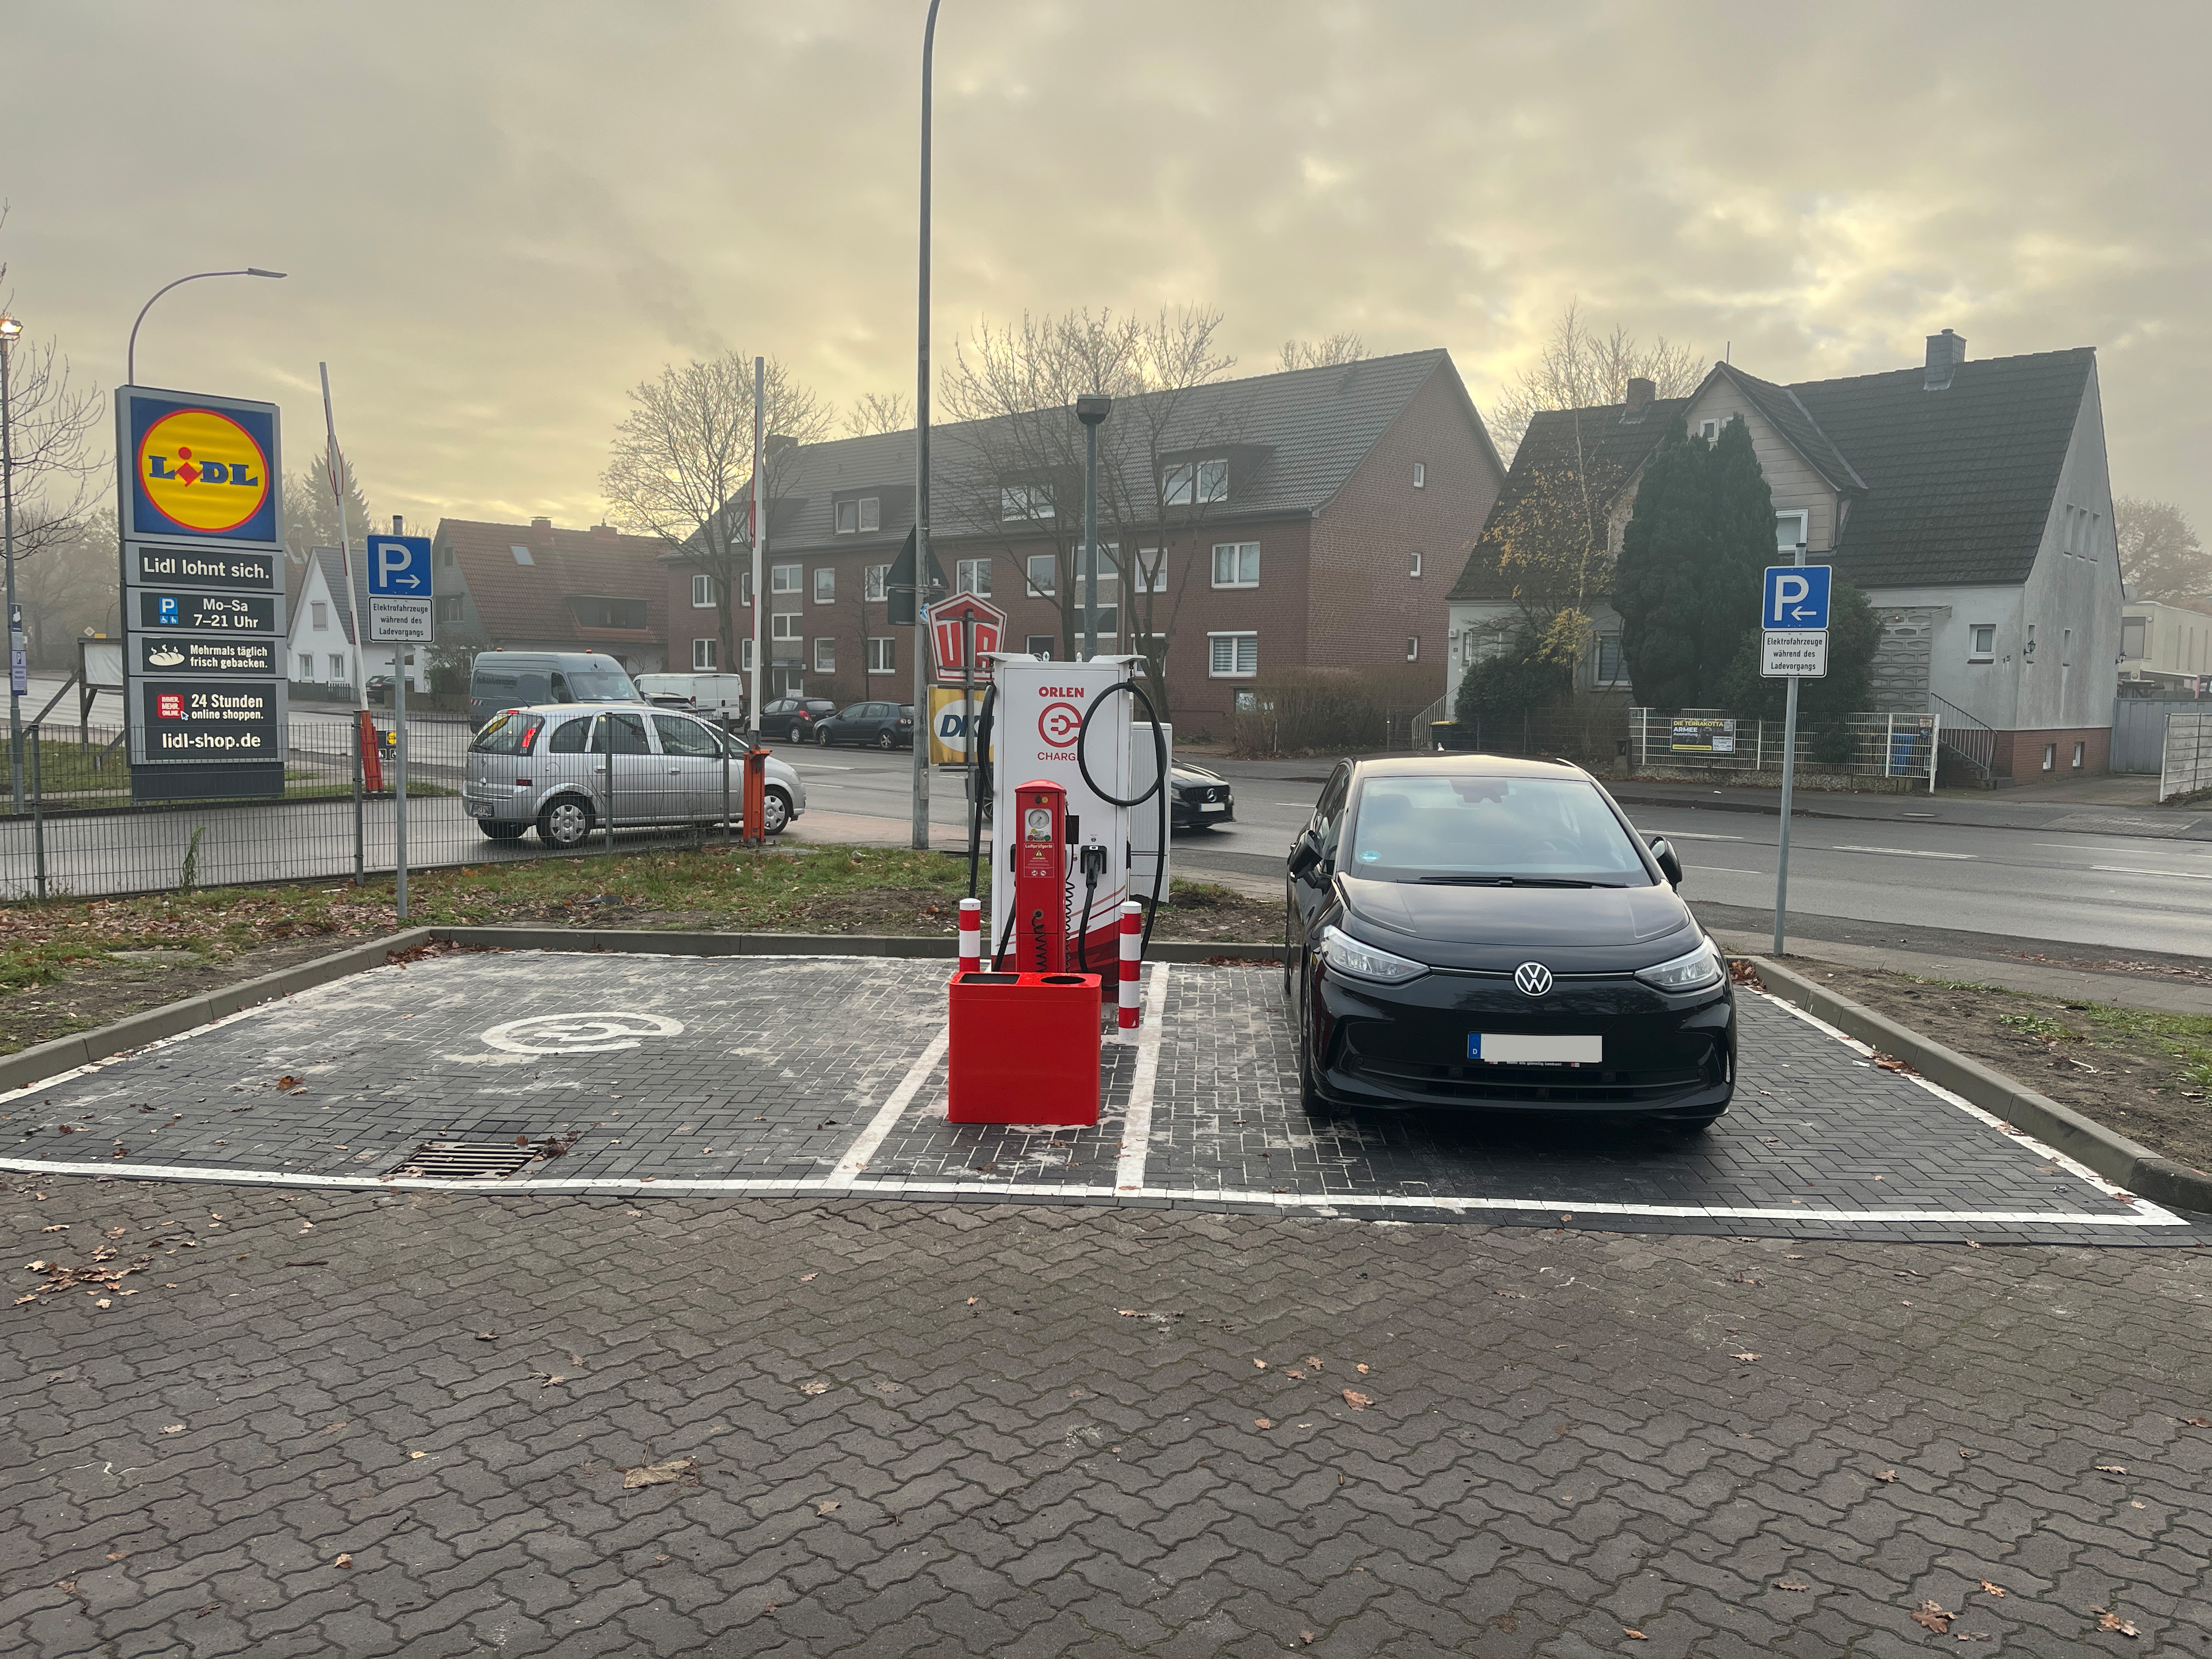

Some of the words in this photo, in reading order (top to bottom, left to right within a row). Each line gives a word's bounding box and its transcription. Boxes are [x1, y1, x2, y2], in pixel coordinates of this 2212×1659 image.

[143, 557, 176, 574] Lidl
[182, 559, 226, 577] lohnt
[231, 562, 270, 579] sich.
[378, 543, 412, 588] P
[1774, 575, 1809, 621] P
[373, 603, 428, 614] Elektrofahrzeuge
[233, 615, 258, 628] Uhr
[380, 616, 408, 624] während
[411, 616, 422, 624] des
[379, 627, 424, 637] Ladevorgangs
[1767, 637, 1822, 647] Elektrofahrzeuge
[190, 644, 235, 656] Mehrmals
[236, 646, 268, 658] täglich
[190, 657, 218, 667] frisch
[221, 657, 268, 669] gebacken.
[2002, 654, 2011, 663] 15
[1771, 662, 1816, 672] Ladevorgangs
[1039, 686, 1085, 698] ORLEN
[191, 693, 208, 708] 24
[211, 694, 263, 708] Stunden
[191, 709, 221, 719] online
[222, 709, 264, 721] shoppen.
[162, 732, 261, 750] lidl-shop.de
[1037, 752, 1079, 761] CHARG
